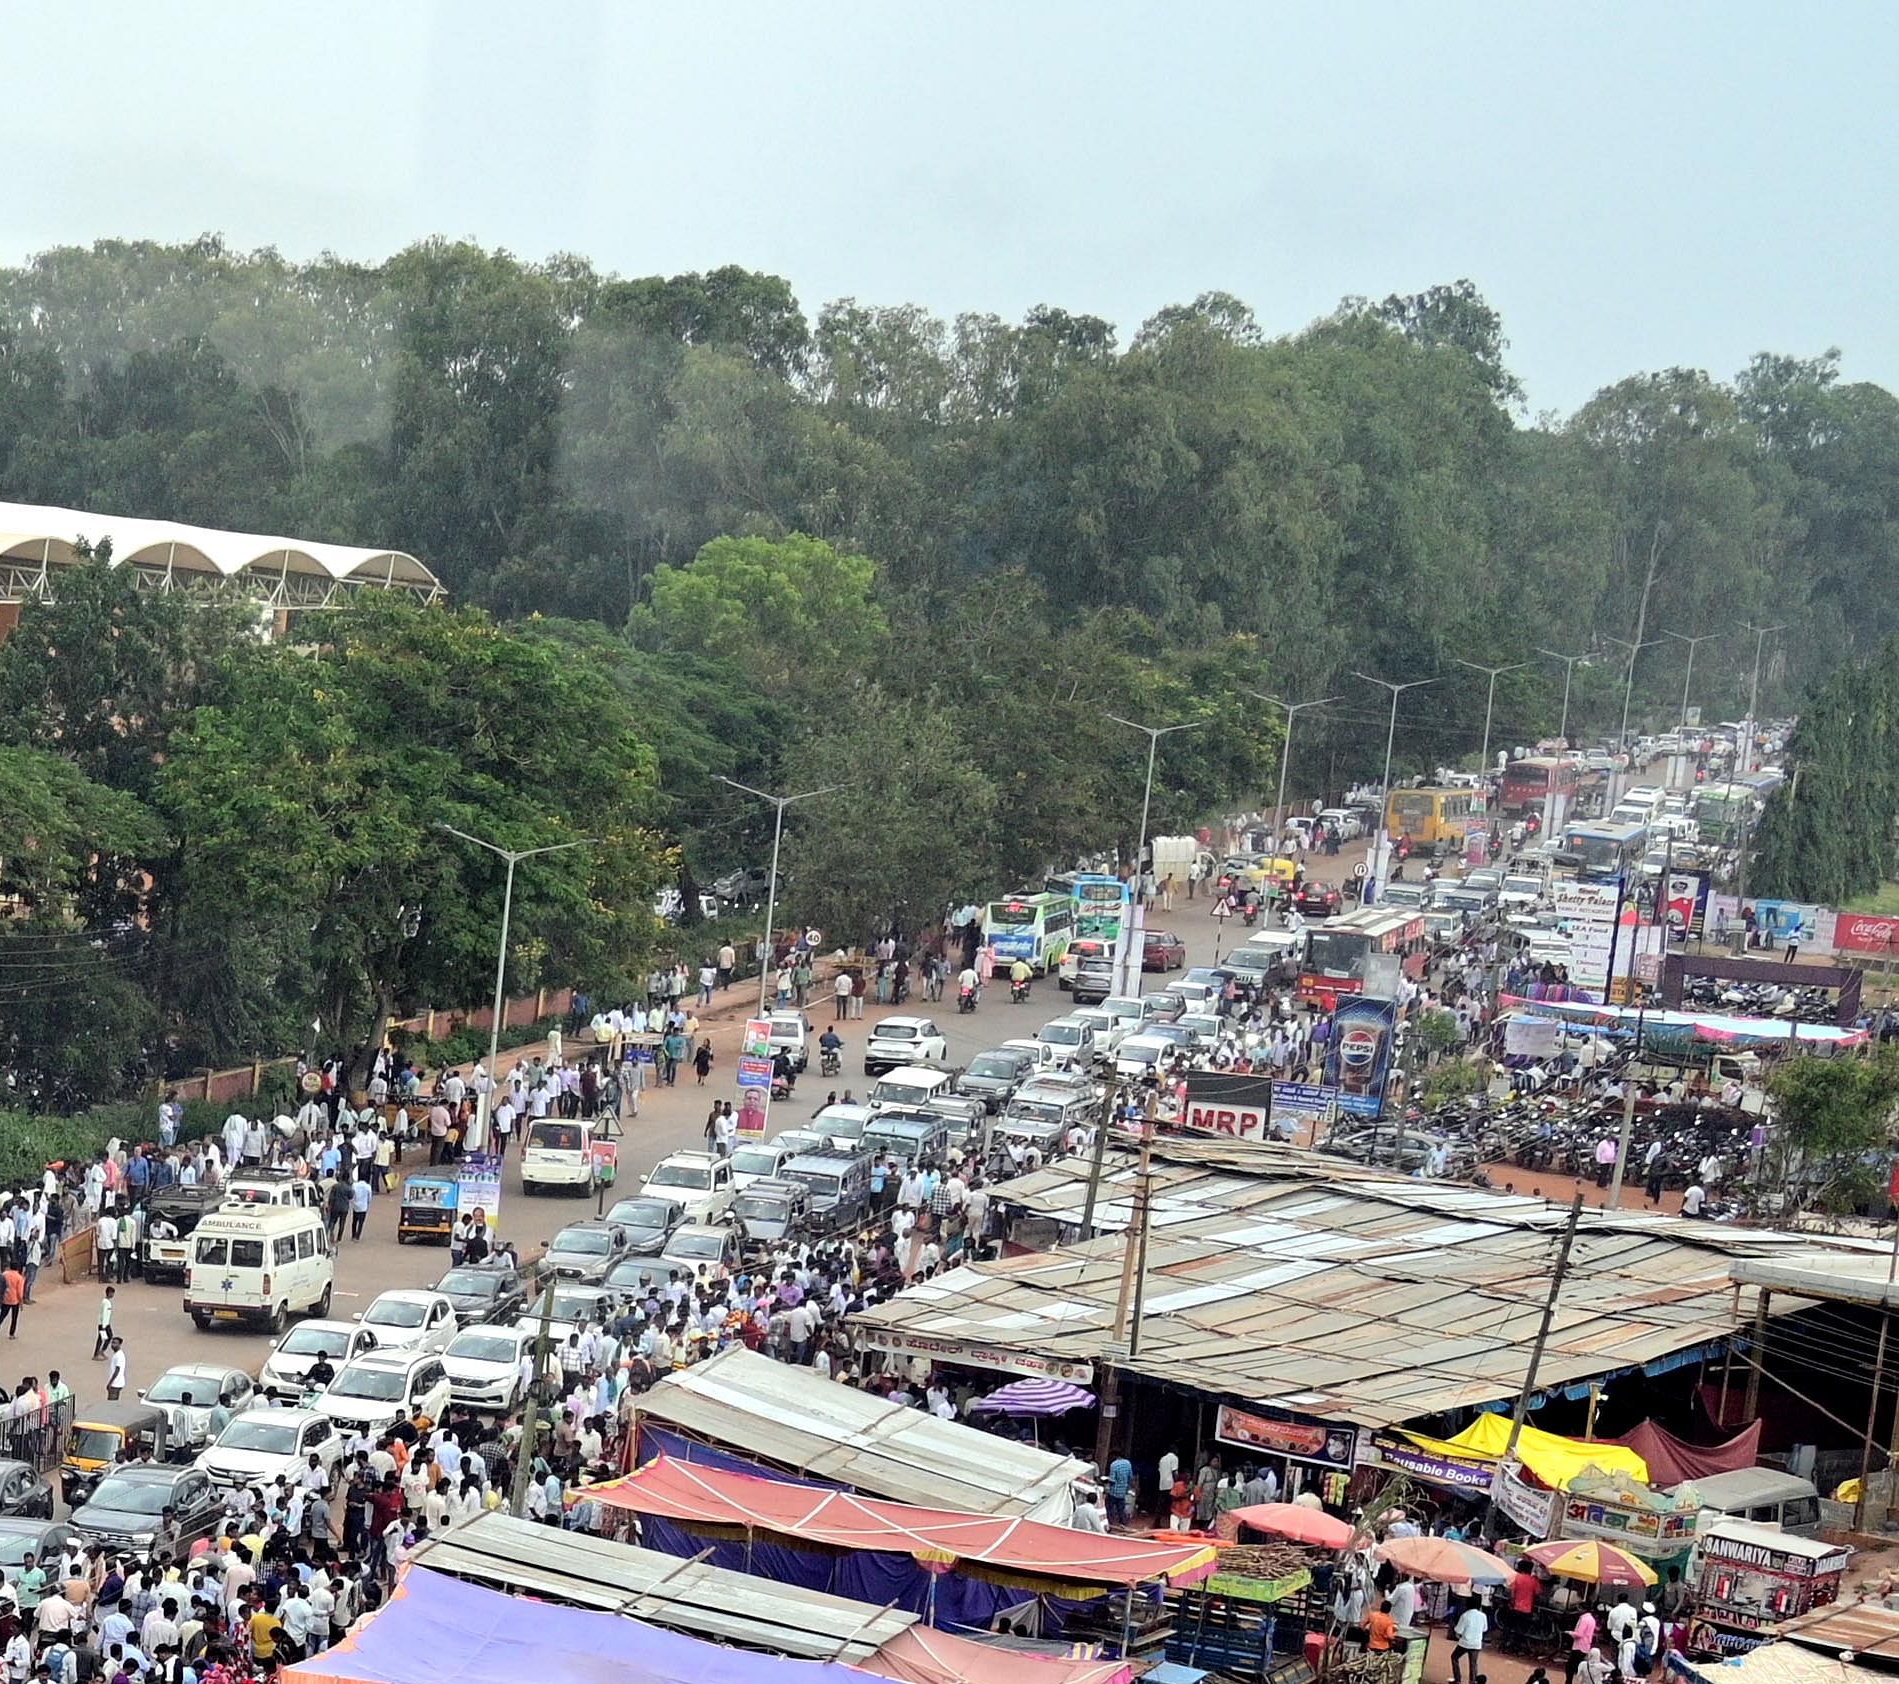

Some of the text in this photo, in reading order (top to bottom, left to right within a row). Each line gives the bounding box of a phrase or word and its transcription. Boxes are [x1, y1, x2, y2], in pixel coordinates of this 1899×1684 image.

[1558, 893, 1586, 906] Shetty
[1342, 1043, 1374, 1054] PEPSI
[1192, 1108, 1258, 1137] MRP
[202, 1220, 263, 1230] AMBULANCE
[1446, 1469, 1488, 1487] Books
[1705, 1536, 1772, 1568] SANWARIYA
